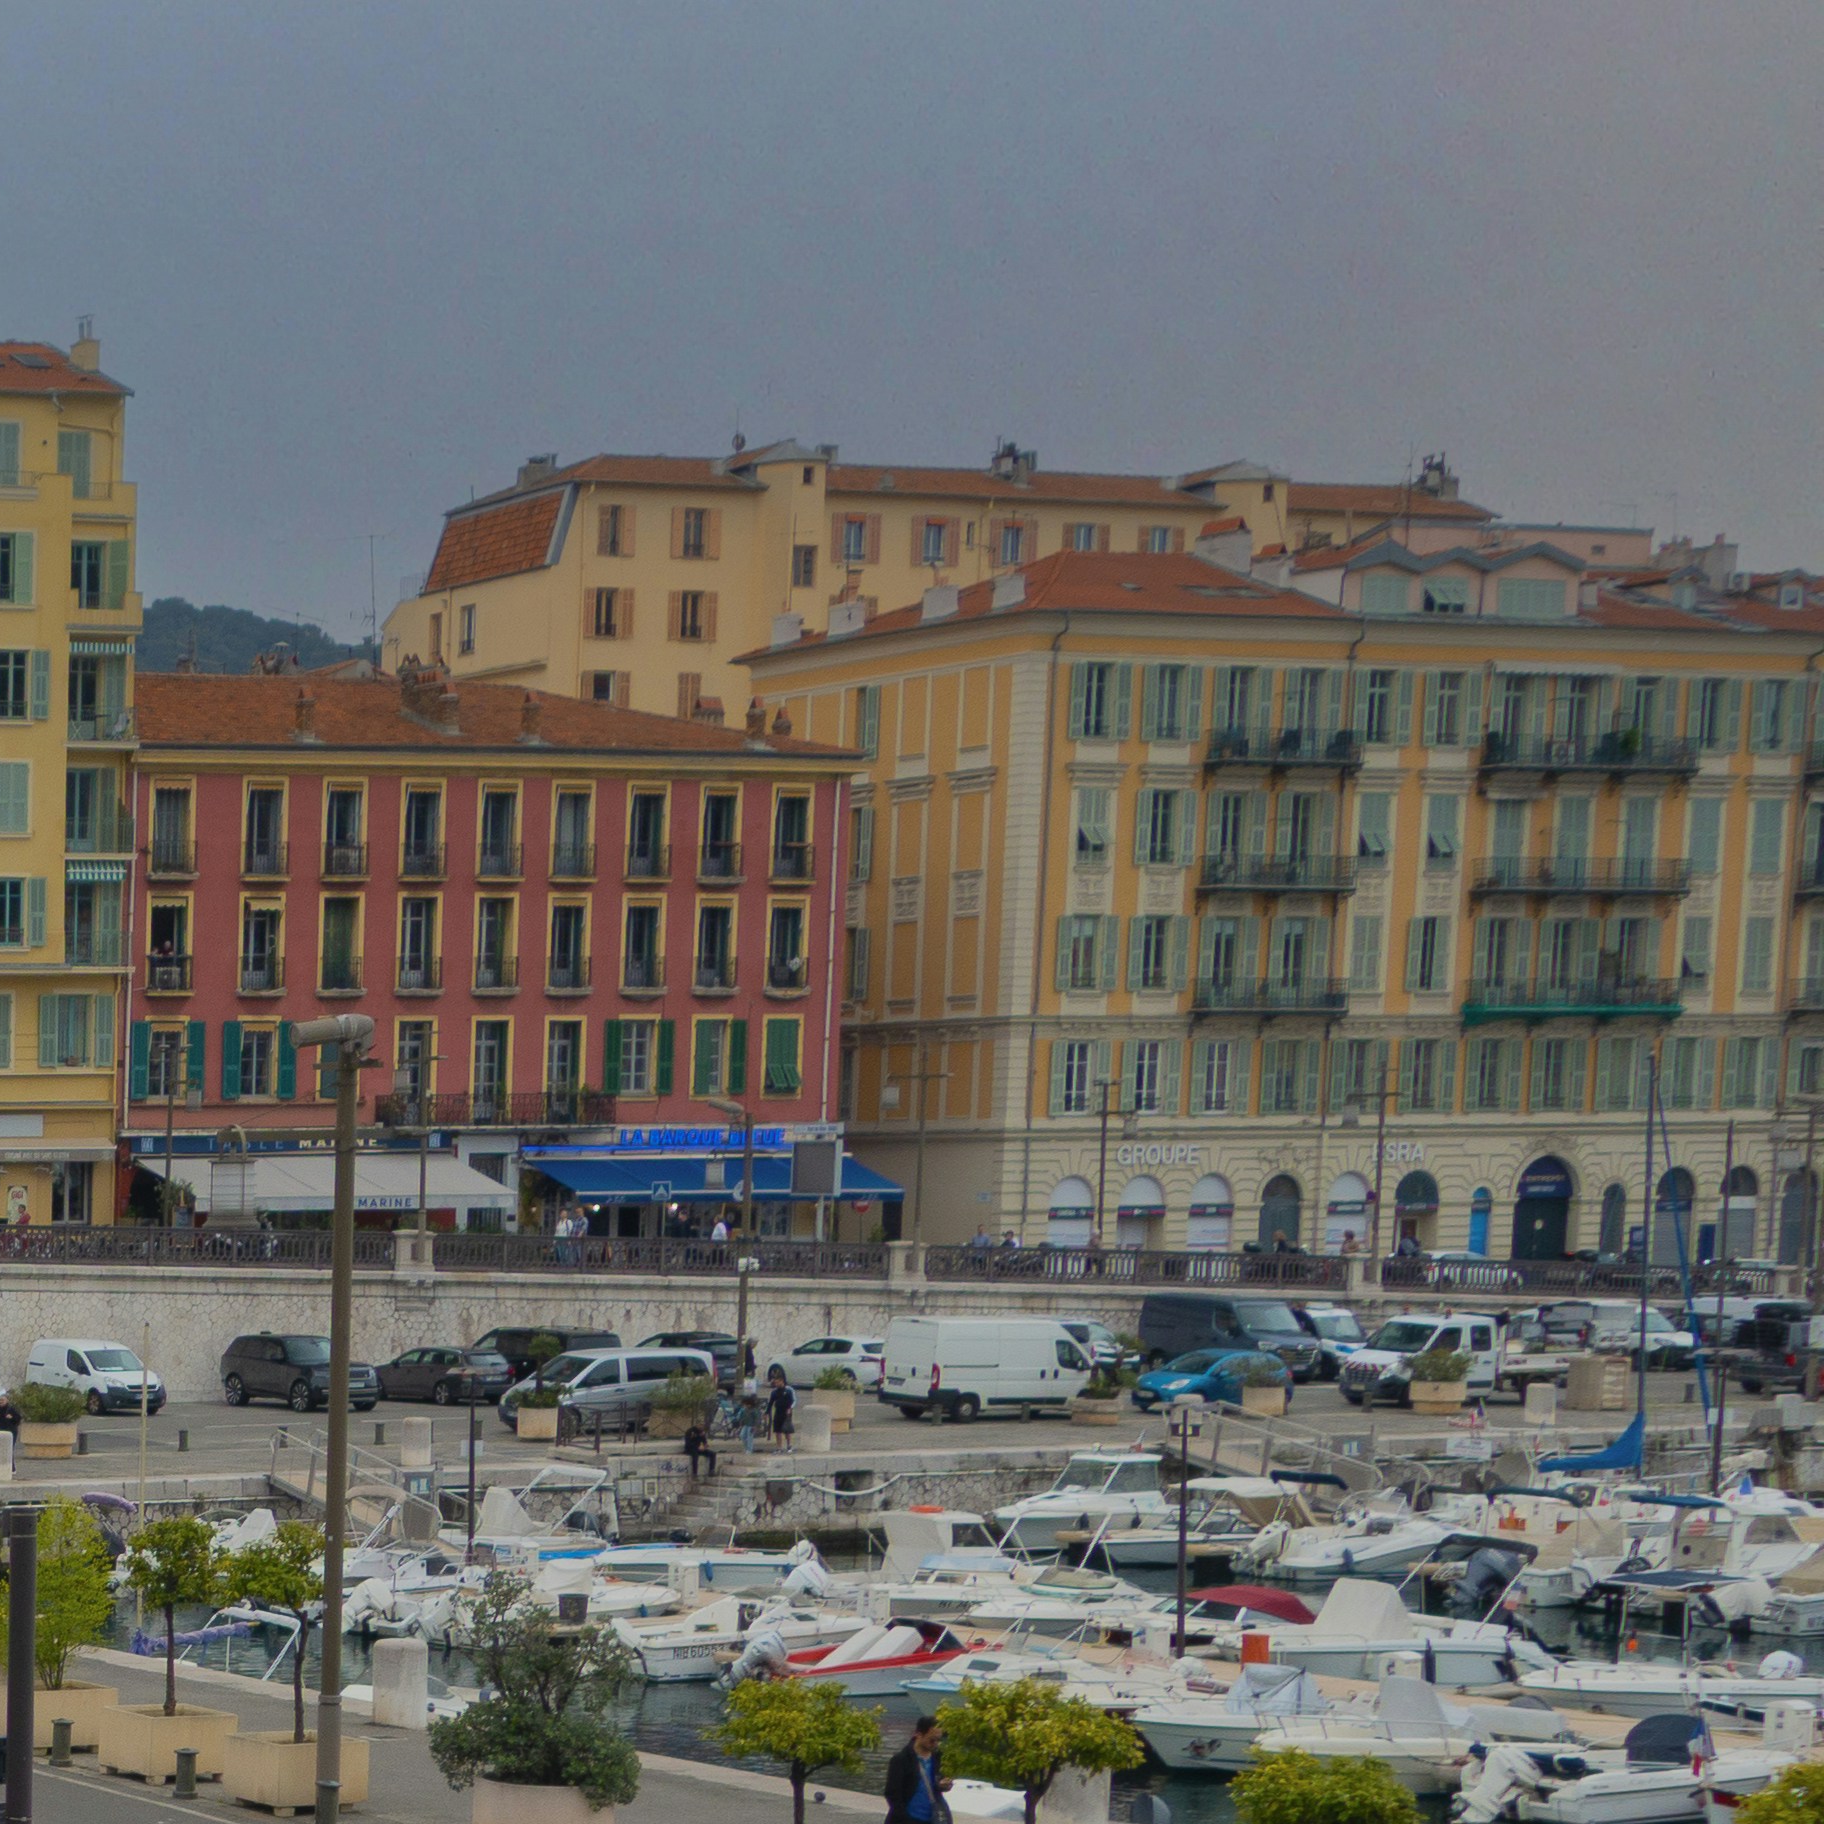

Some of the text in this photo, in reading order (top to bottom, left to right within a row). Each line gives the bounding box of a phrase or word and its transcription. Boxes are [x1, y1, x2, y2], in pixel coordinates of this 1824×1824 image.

[620, 1128, 643, 1146] LA
[649, 1128, 725, 1146] BARQUE
[1117, 1143, 1201, 1165] GROUPE
[11, 1190, 24, 1199] GIGI
[358, 1198, 412, 1207] MARINE
